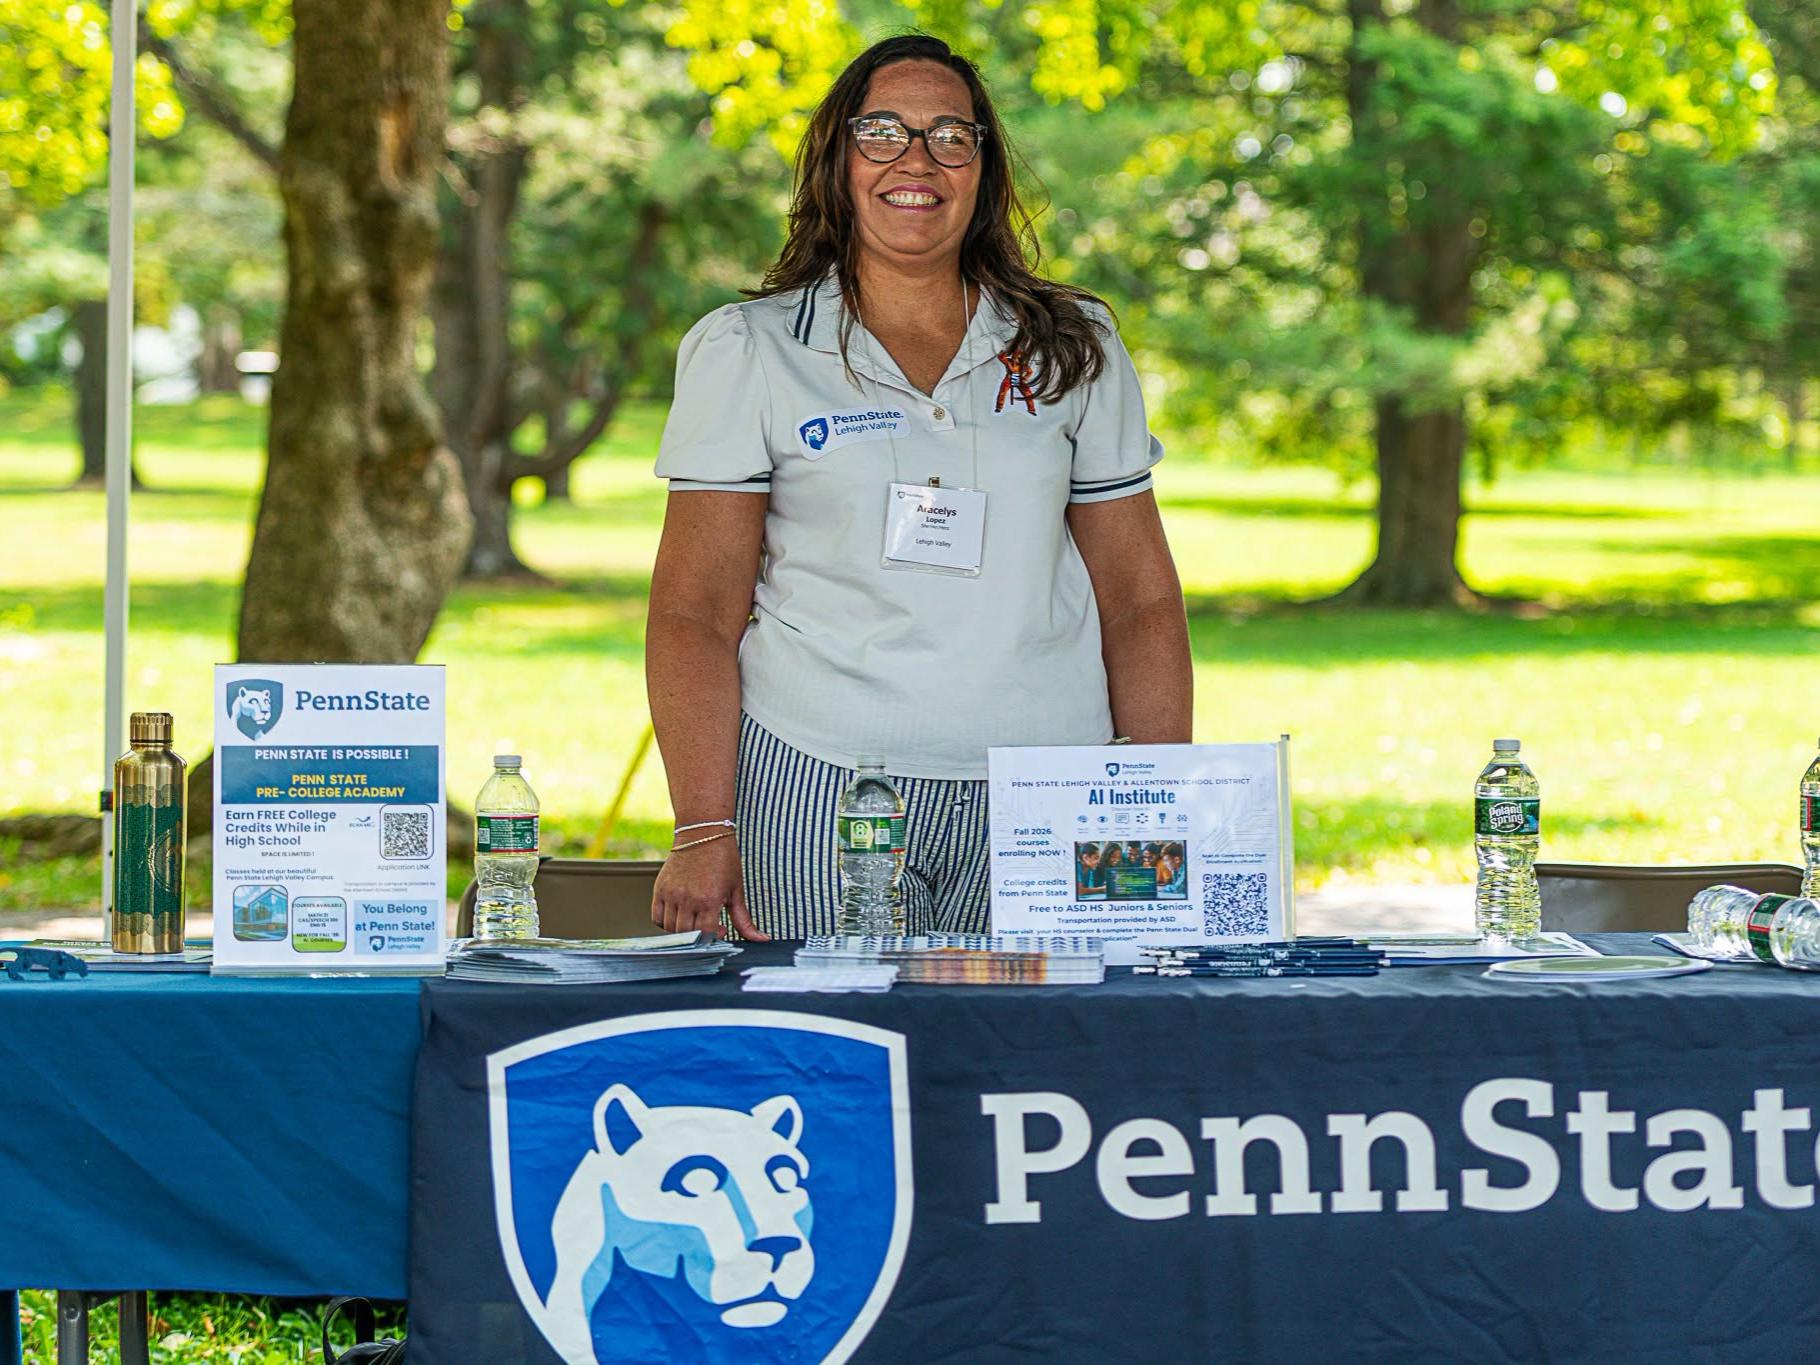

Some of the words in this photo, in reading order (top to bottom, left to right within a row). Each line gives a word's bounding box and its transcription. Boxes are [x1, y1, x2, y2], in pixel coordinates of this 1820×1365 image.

[832, 411, 902, 424] PennState
[835, 424, 868, 435] Lehigh
[869, 422, 897, 430] Valley
[917, 505, 957, 517] Aracelys
[926, 516, 946, 524] Lopez
[916, 538, 935, 547] Lehigh
[935, 539, 952, 548] Valley
[296, 691, 430, 710] PennState
[255, 749, 287, 760] PENN
[290, 749, 328, 760] STATE
[333, 749, 344, 760] IS
[346, 749, 402, 760] POSSIBLE
[292, 775, 324, 785] PENN
[330, 775, 367, 785] STATE
[256, 787, 286, 798] PRE-
[288, 787, 341, 798] COLLEGE
[343, 787, 405, 798] ACADEMY
[1088, 789, 1103, 805] AI
[1110, 789, 1176, 804] Institute
[226, 810, 254, 820] Earn
[257, 810, 285, 820] FREE
[288, 810, 336, 822] College
[1489, 803, 1523, 819] Poland
[1490, 814, 1524, 830] Spring
[226, 823, 272, 833] Credits
[275, 823, 311, 833] While
[314, 823, 326, 833] in
[226, 836, 255, 848] High
[258, 836, 301, 846] School
[998, 850, 1036, 858] enrolling
[1003, 879, 1036, 888] College
[1046, 889, 1068, 897] State
[362, 904, 384, 914] You
[387, 904, 427, 915] Belong
[1029, 905, 1051, 913] Free
[1053, 905, 1064, 913] to
[1066, 904, 1087, 912] ASD
[1090, 904, 1104, 912] HS
[1108, 903, 1145, 912] Juniors
[1147, 903, 1154, 911] &
[1157, 903, 1193, 911] Seniors
[355, 922, 366, 931] at
[369, 922, 399, 931] Penn
[402, 921, 435, 931] State!
[1057, 917, 1112, 925] Transportation
[1114, 916, 1147, 924] provided
[1149, 916, 1158, 924] by
[980, 1077, 1820, 1225] PennStat
